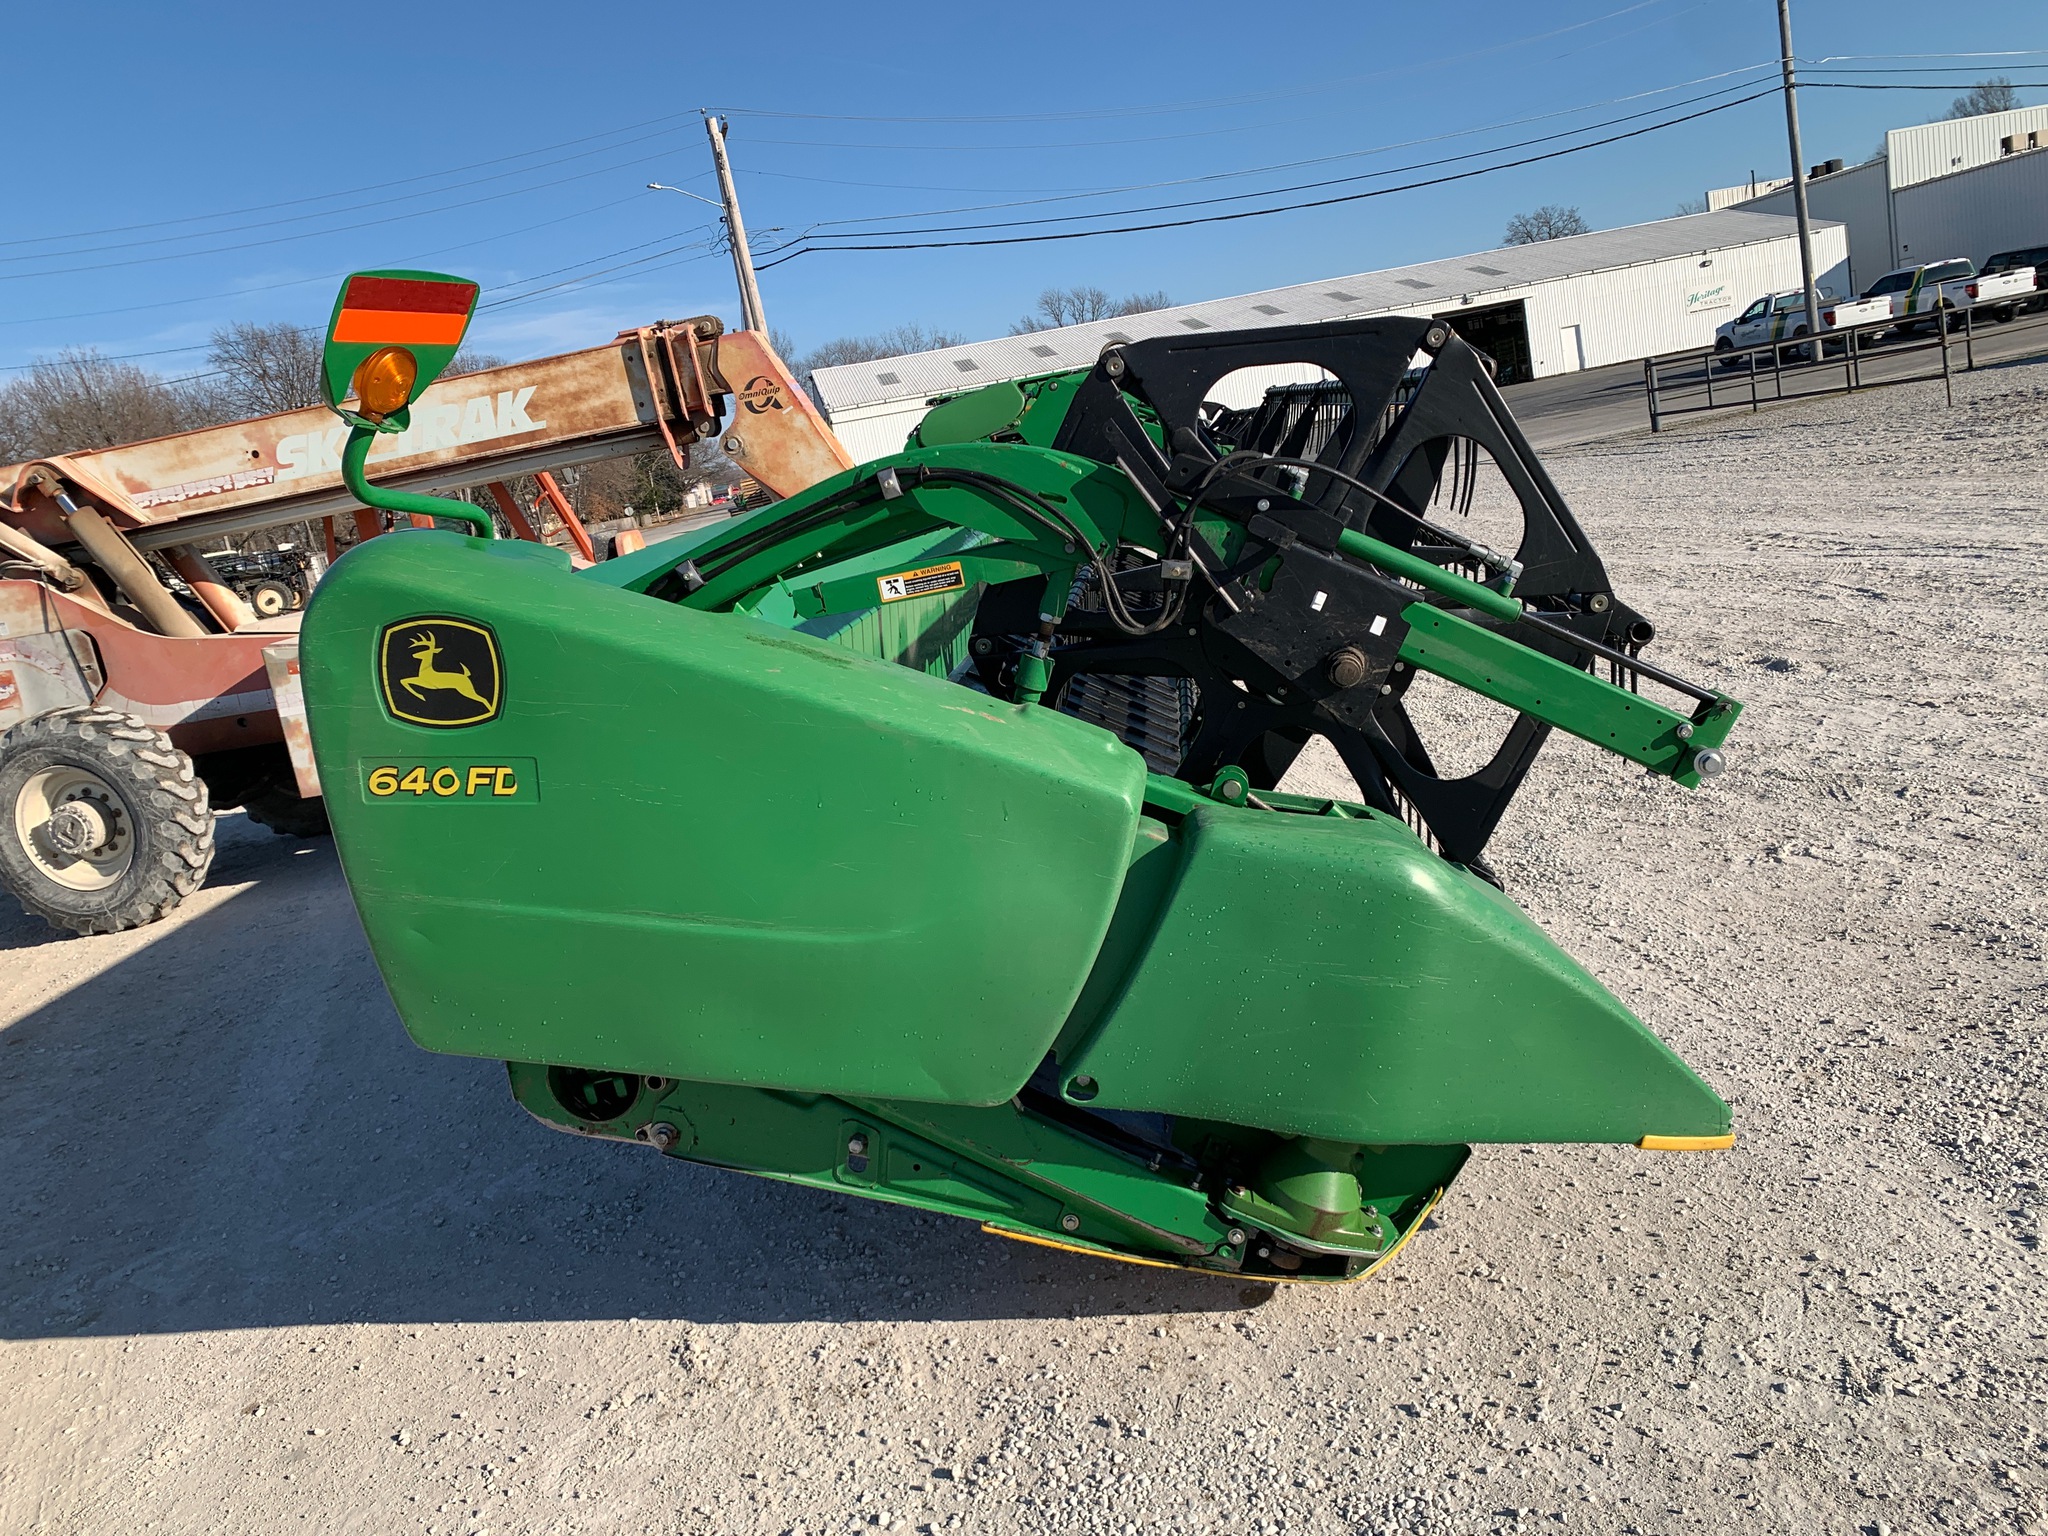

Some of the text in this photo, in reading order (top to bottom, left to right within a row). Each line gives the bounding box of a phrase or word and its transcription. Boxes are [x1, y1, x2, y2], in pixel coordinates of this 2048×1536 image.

[1687, 286, 1725, 307] Heritage
[1700, 296, 1731, 305] TRACTOR
[738, 386, 780, 400] OmniQuip
[276, 385, 546, 482] SKTRAK
[920, 564, 951, 576] WARNING
[368, 765, 518, 796] 640 FD
